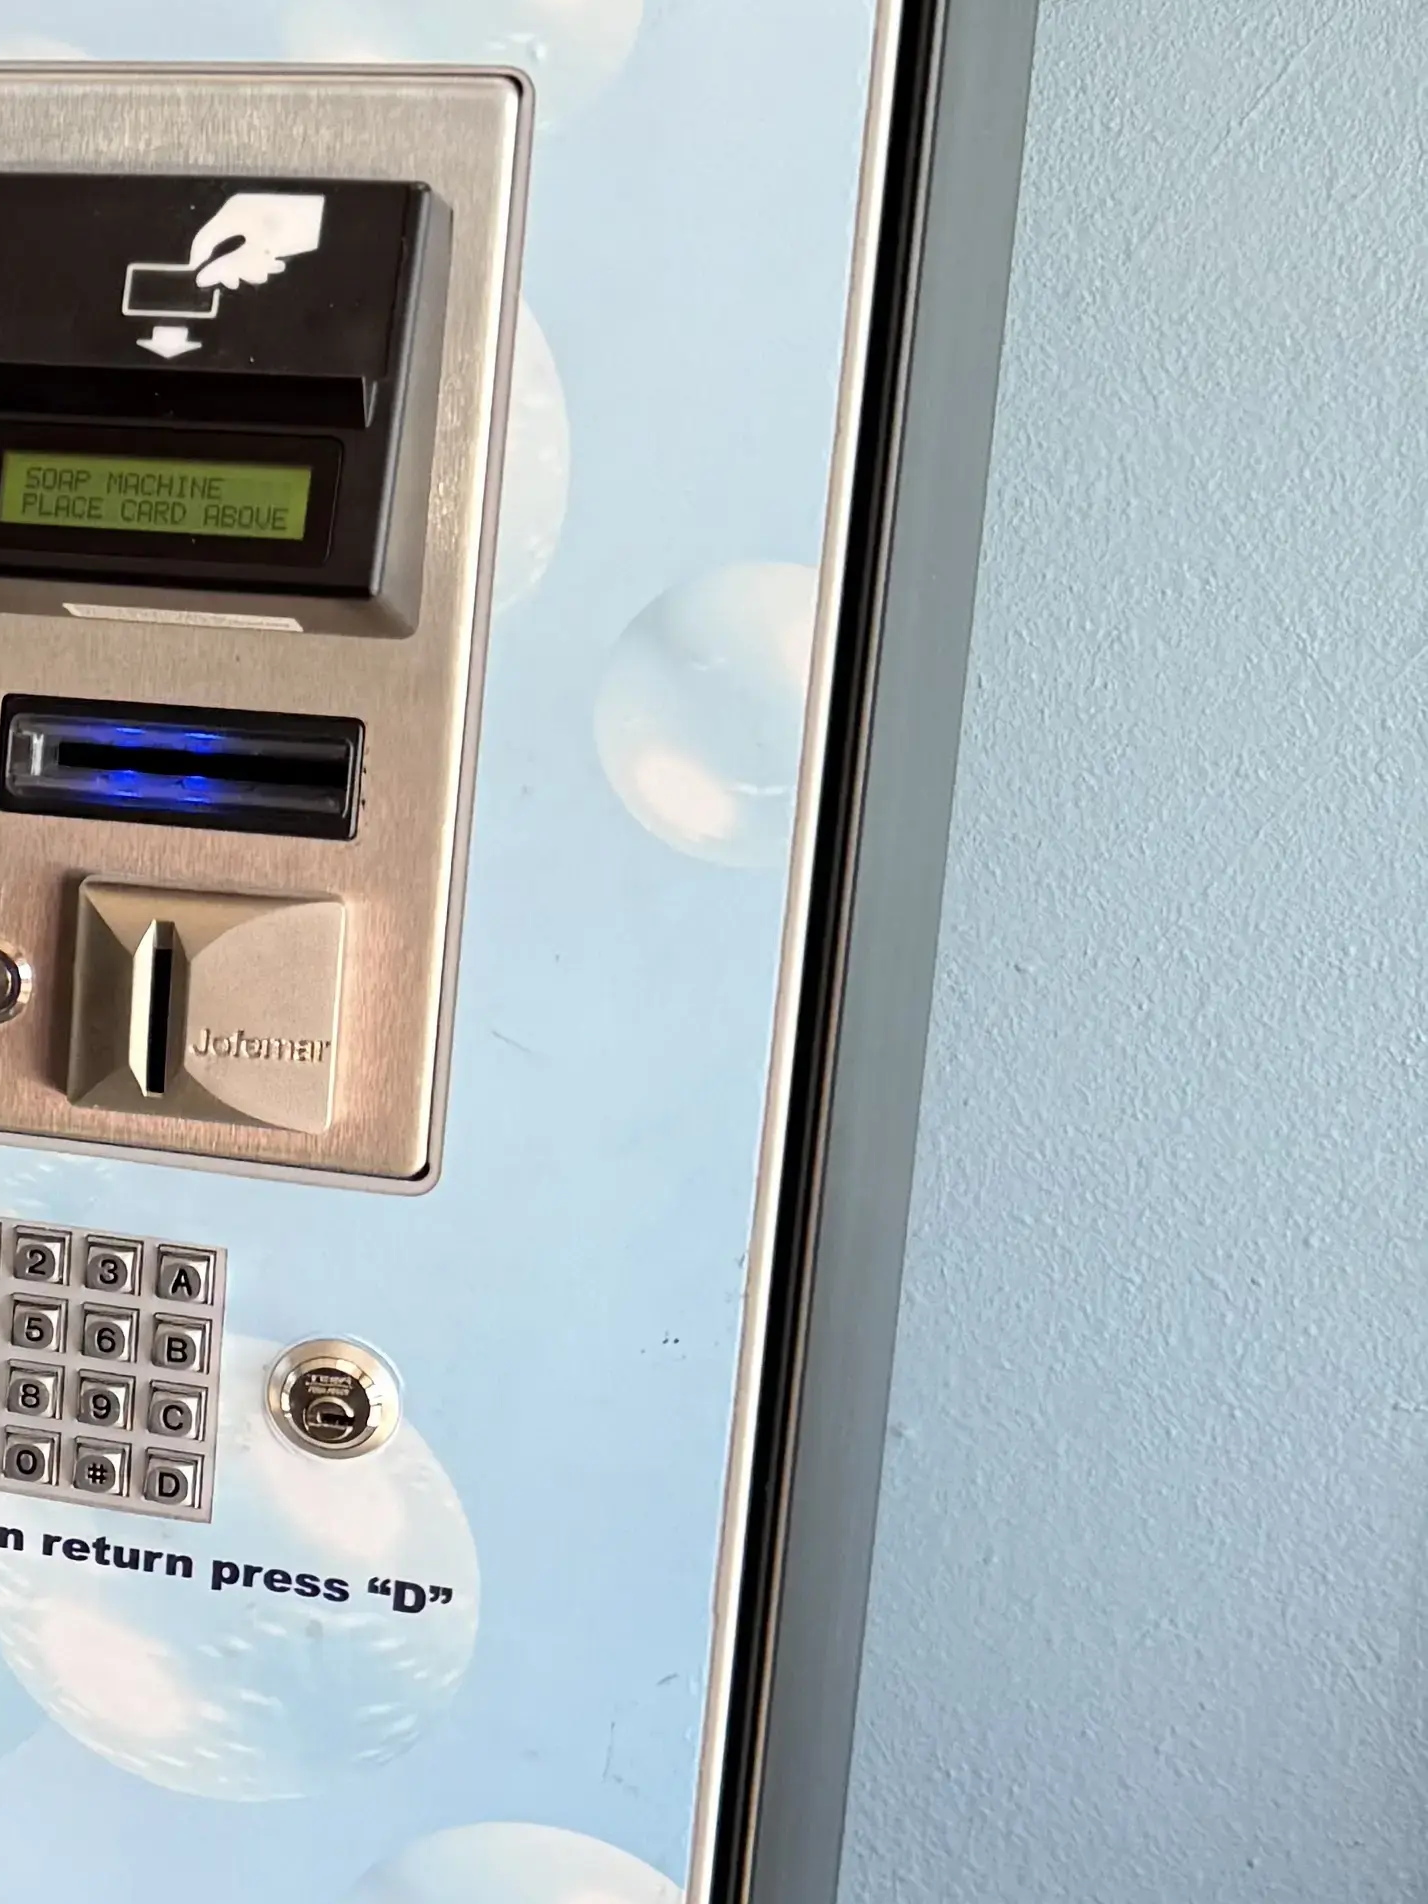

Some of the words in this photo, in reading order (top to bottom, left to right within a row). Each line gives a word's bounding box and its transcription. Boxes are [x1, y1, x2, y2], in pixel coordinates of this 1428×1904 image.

[25, 467, 92, 496] SOAP
[107, 471, 223, 500] MACHINE
[22, 492, 104, 520] PLACE
[121, 499, 187, 527] CARD
[203, 503, 290, 532] ABOVE
[190, 1025, 333, 1066] Jofemar
[26, 1249, 48, 1278] 2
[99, 1258, 120, 1286] 3
[170, 1267, 194, 1295] A
[24, 1315, 45, 1344] 5
[96, 1326, 116, 1355] 6
[166, 1335, 189, 1364] B
[21, 1382, 42, 1411] 8
[92, 1392, 113, 1421] 9
[161, 1404, 186, 1433] C
[158, 1471, 181, 1499] D
[41, 1529, 194, 1581] return
[211, 1556, 351, 1606] press
